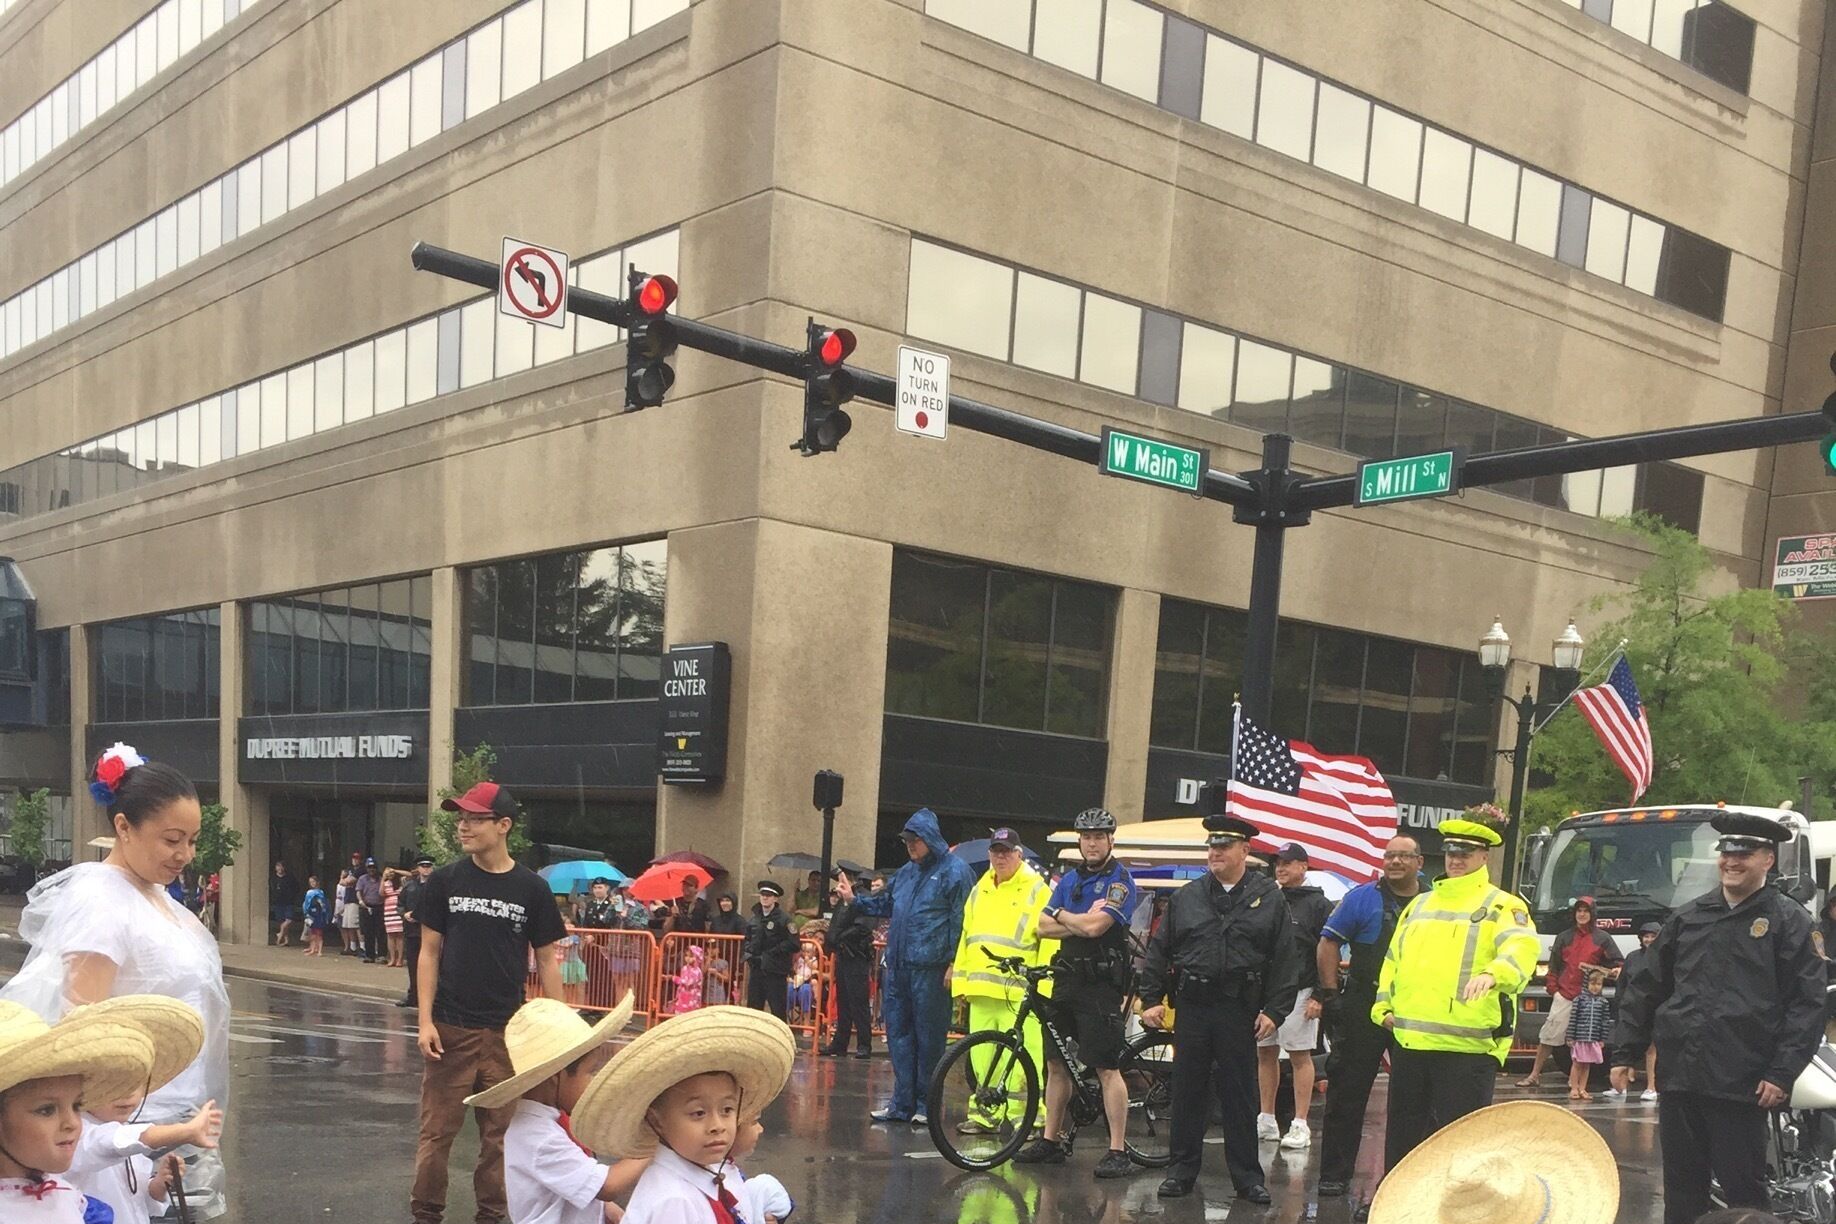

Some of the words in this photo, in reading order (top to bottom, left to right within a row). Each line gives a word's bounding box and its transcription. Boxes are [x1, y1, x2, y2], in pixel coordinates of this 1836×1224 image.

[913, 356, 934, 374] NO
[909, 375, 938, 393] TURN
[902, 391, 917, 406] ON
[922, 395, 943, 412] RED
[1114, 438, 1129, 468] W
[1135, 443, 1178, 480] Main
[1182, 453, 1194, 469] St
[1180, 471, 1194, 485] 301
[1365, 482, 1373, 497] S
[1376, 463, 1417, 496] Mill
[1422, 461, 1435, 476] St
[1438, 471, 1447, 488] N
[1777, 566, 1807, 578] (859)
[673, 659, 699, 677] VINE
[664, 679, 707, 697] CENTER
[247, 738, 299, 758] DUPREE
[299, 736, 356, 758] MUTUAL
[358, 735, 412, 758] FUNDS
[1596, 918, 1632, 928] GMC
